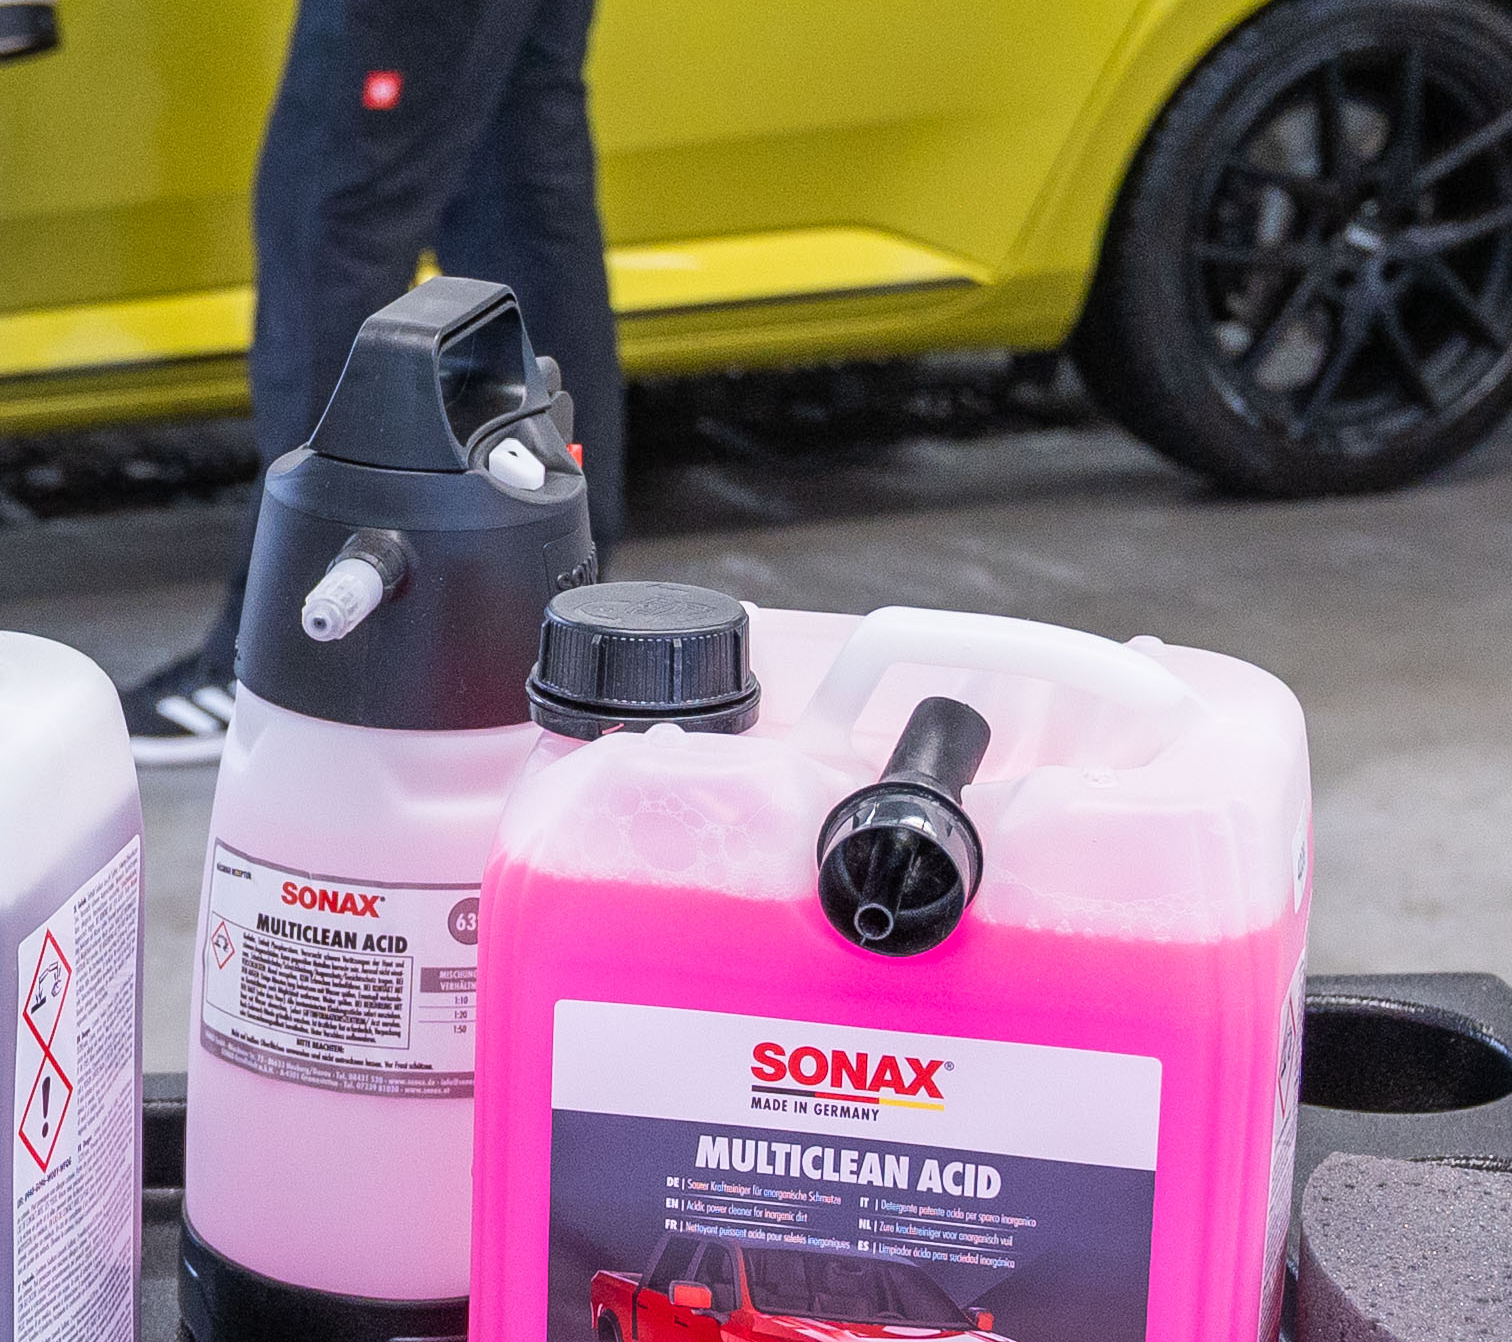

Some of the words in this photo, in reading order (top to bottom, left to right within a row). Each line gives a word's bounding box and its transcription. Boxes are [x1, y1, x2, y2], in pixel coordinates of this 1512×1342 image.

[281, 881, 380, 918] SONAX
[256, 913, 357, 950] MULTICLEAN
[363, 936, 408, 953] ACID
[456, 912, 478, 931] 63
[455, 996, 468, 1005] 1:10
[454, 1011, 467, 1019] 1:20
[453, 1025, 467, 1034] 1:50
[751, 1042, 945, 1100] SONAX
[750, 1096, 788, 1113] MADE
[793, 1099, 808, 1115] IN
[813, 1102, 880, 1122] GERMANY
[695, 1135, 911, 1189] MULTICLEAN
[916, 1159, 1002, 1200] ACID
